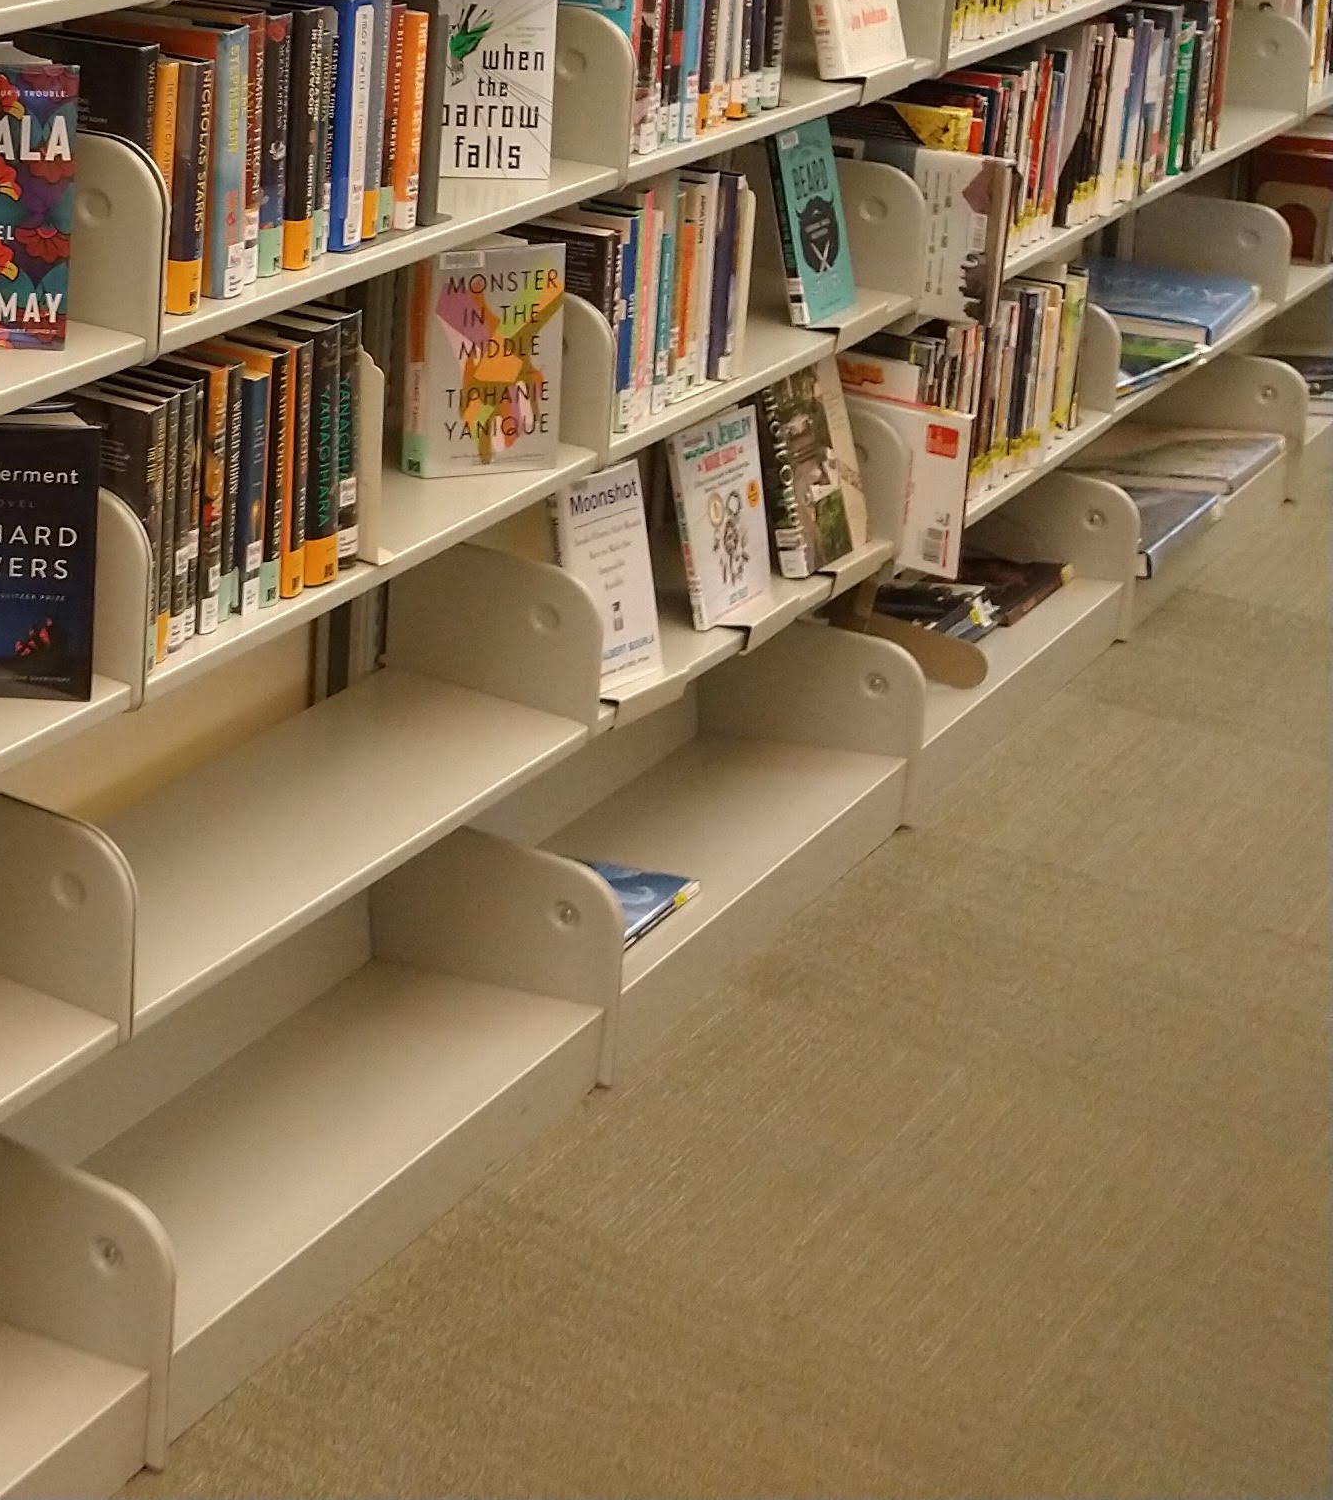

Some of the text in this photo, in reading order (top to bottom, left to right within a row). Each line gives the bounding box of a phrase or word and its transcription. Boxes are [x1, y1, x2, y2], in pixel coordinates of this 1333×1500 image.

[482, 44, 544, 72] when
[477, 76, 508, 98] the
[194, 69, 213, 233] NICHOLAS SPARKS
[453, 136, 521, 170] falls
[792, 158, 829, 201] BEARD
[448, 268, 559, 295] MONSTER
[463, 303, 541, 326] IN THE
[459, 335, 541, 361] MIDDLE
[444, 414, 549, 442] YANIQUE
[570, 480, 638, 518] Moonshot
